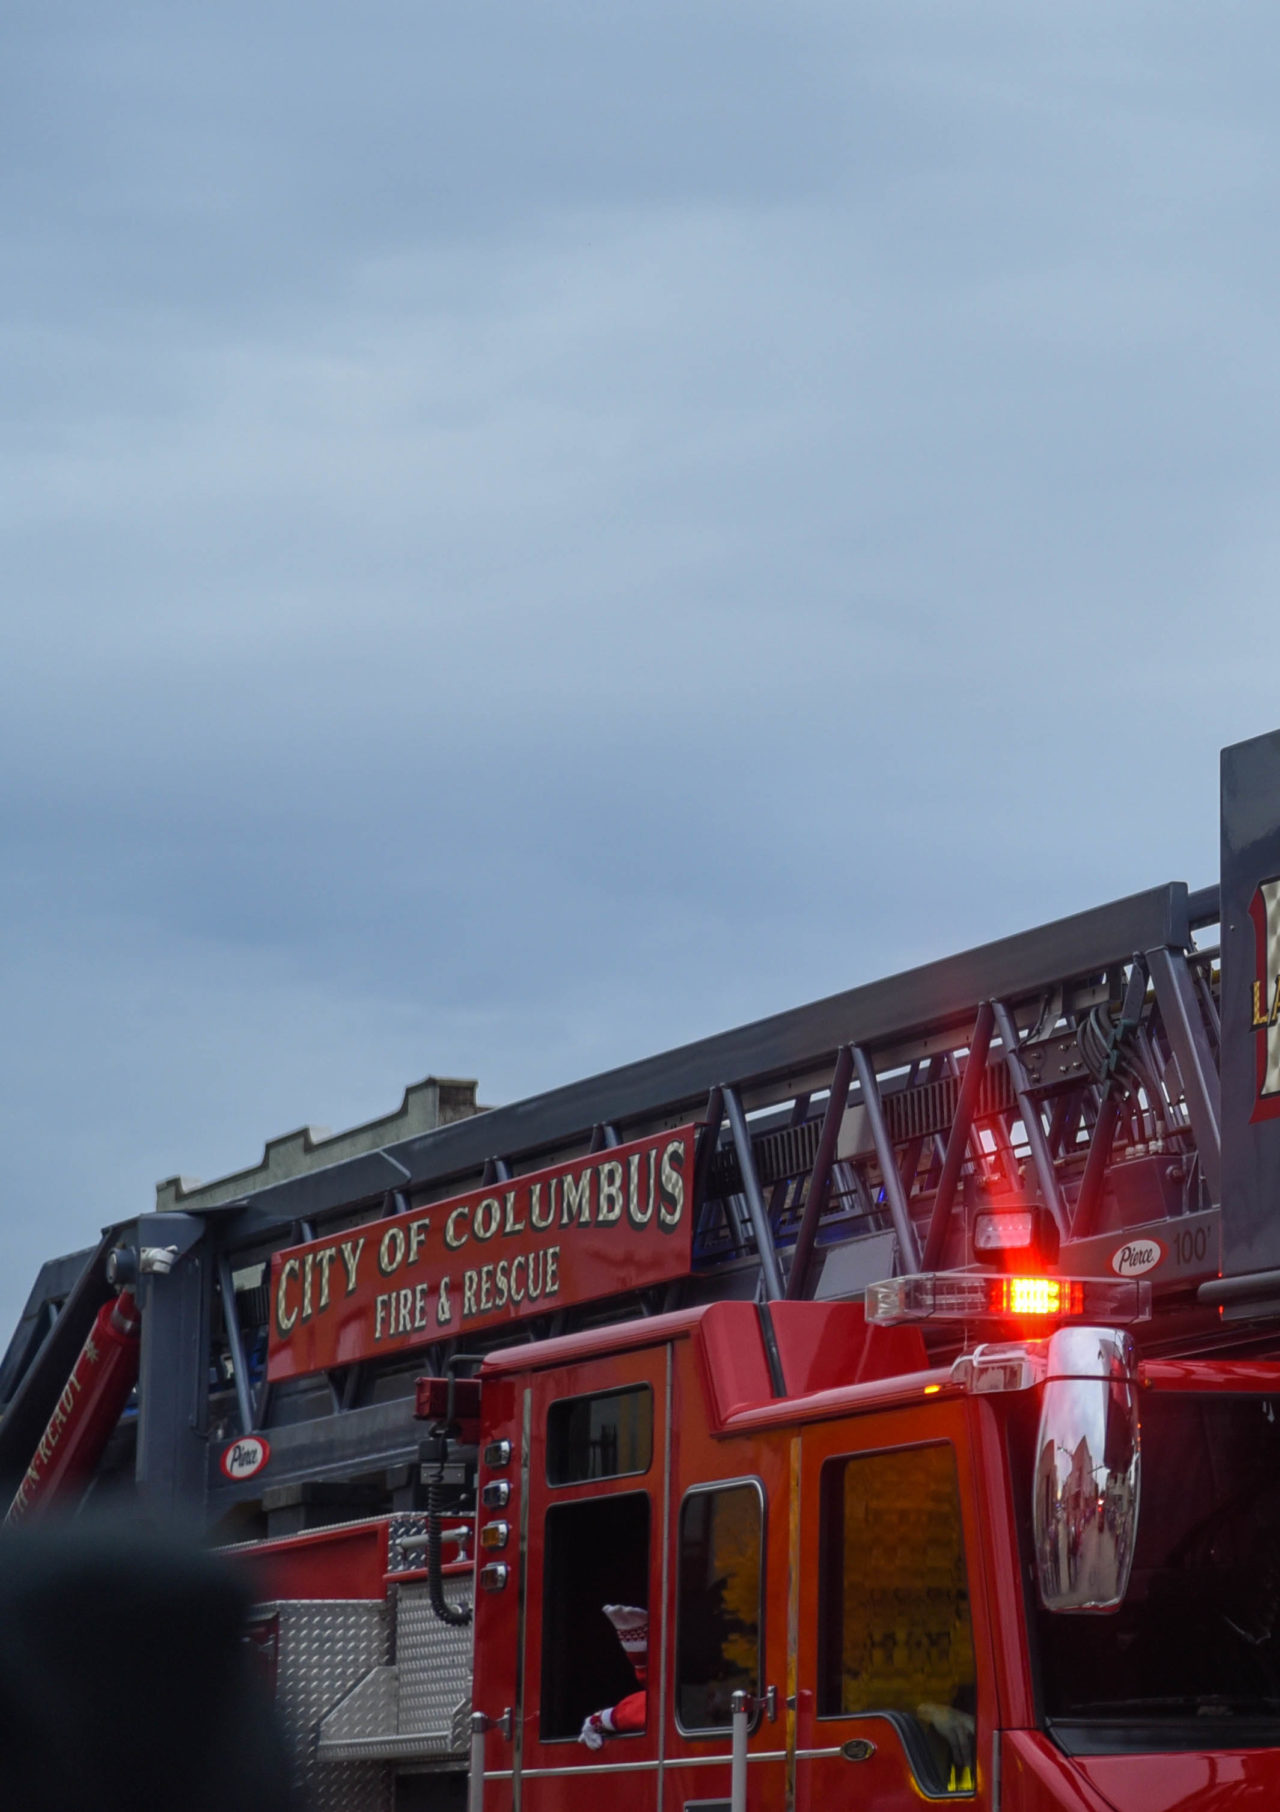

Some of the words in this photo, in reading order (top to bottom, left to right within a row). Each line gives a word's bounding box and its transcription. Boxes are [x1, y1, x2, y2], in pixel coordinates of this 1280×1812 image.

[277, 1238, 365, 1334] CITY
[379, 1217, 430, 1274] OF
[445, 1140, 686, 1250] COLUMBUS
[1118, 1245, 1154, 1274] Pierce
[374, 1282, 428, 1340] FIRE
[437, 1276, 451, 1324] &
[462, 1245, 561, 1317] RESCUE
